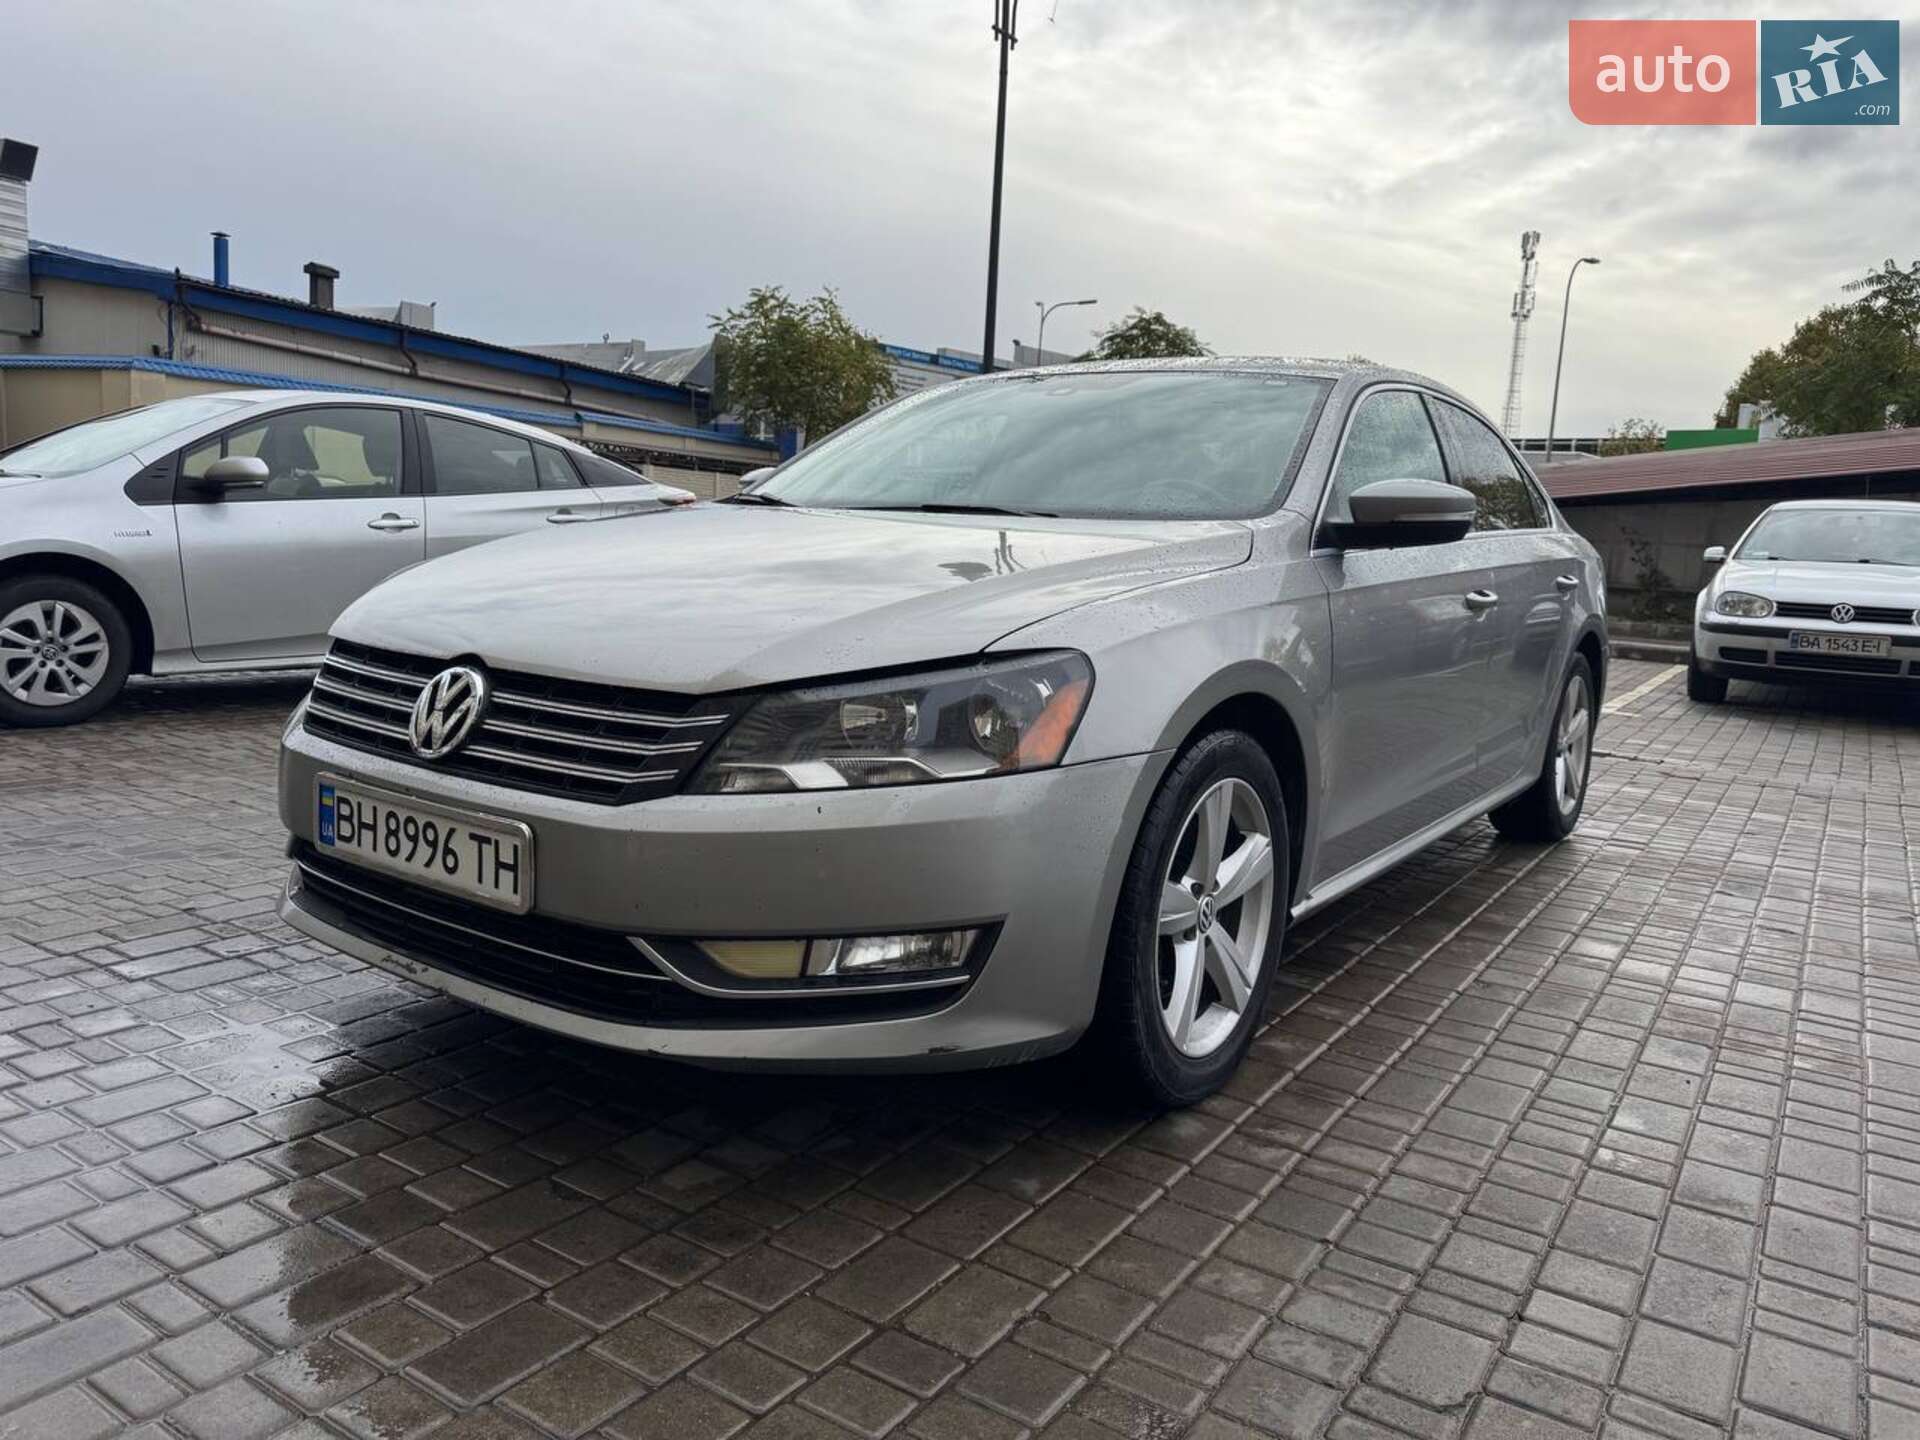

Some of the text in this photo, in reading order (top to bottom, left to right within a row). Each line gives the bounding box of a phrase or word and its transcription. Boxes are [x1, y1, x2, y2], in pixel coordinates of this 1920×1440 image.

[1800, 635, 1820, 649] BA
[1826, 638, 1859, 652] 1543
[409, 667, 484, 757] VW
[321, 821, 335, 838] UA
[336, 795, 519, 895] BH 8996 TH
